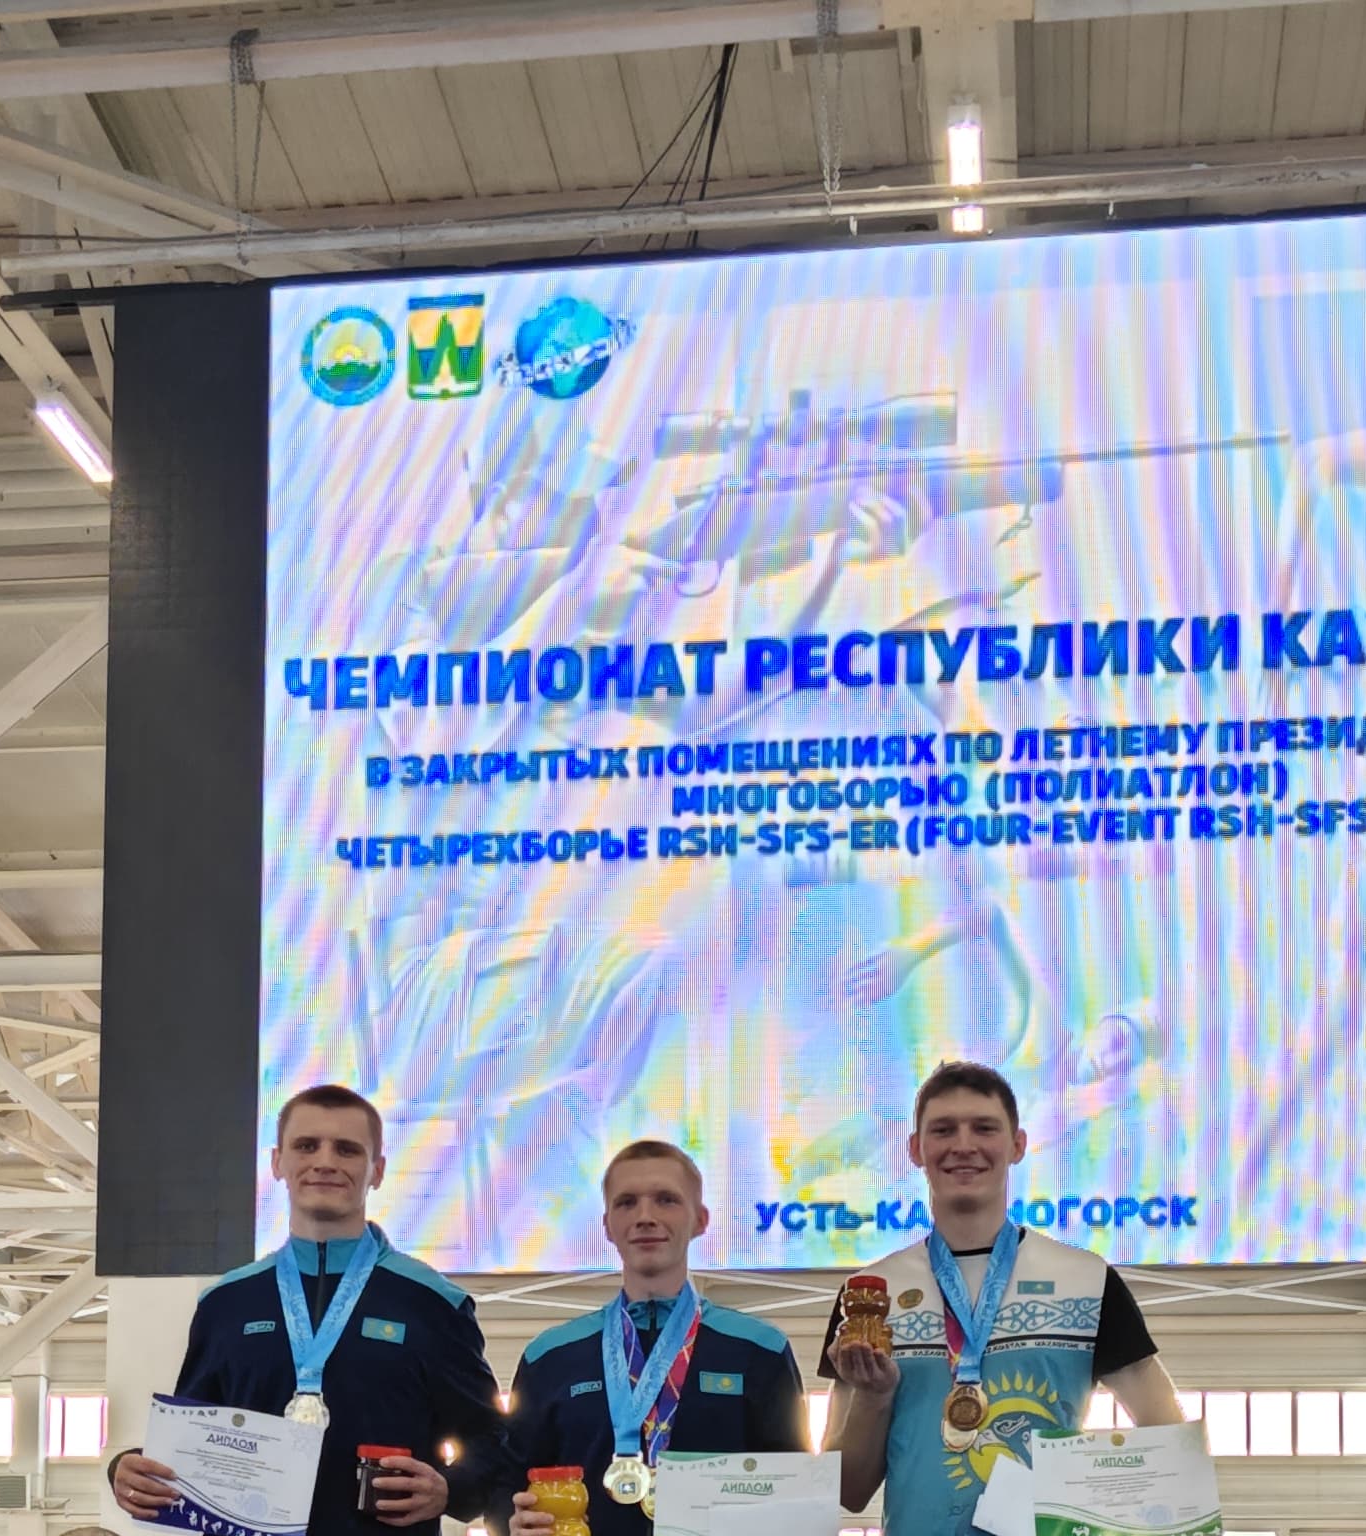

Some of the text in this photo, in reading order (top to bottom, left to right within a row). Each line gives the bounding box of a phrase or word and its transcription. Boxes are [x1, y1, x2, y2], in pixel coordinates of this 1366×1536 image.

[285, 642, 726, 710] ЧЕМПИОНАТ
[745, 613, 1239, 694] РЕСПУБЛИКИ
[367, 757, 391, 787] В
[400, 748, 627, 787] ЗАКРЫТЫХ
[637, 733, 936, 775] ПОМЕЩЕНИЯХ
[944, 733, 1002, 764] ПО
[1012, 723, 1209, 761] ЛЕТНЕМУ
[673, 761, 1288, 816] МНОГОБОРЬЮ (ПОЛИАТЛОН)
[337, 828, 647, 870] ЧЕТЫРЕХБОРЬЕ
[659, 814, 898, 857] RSH-SFS-ER
[904, 808, 1180, 854] (FOUR-EVENT
[206, 1433, 257, 1452] ДИПЛОМ
[1093, 1455, 1145, 1468] ДИПЛОМ
[720, 1482, 773, 1495] ДИПЛОМ
